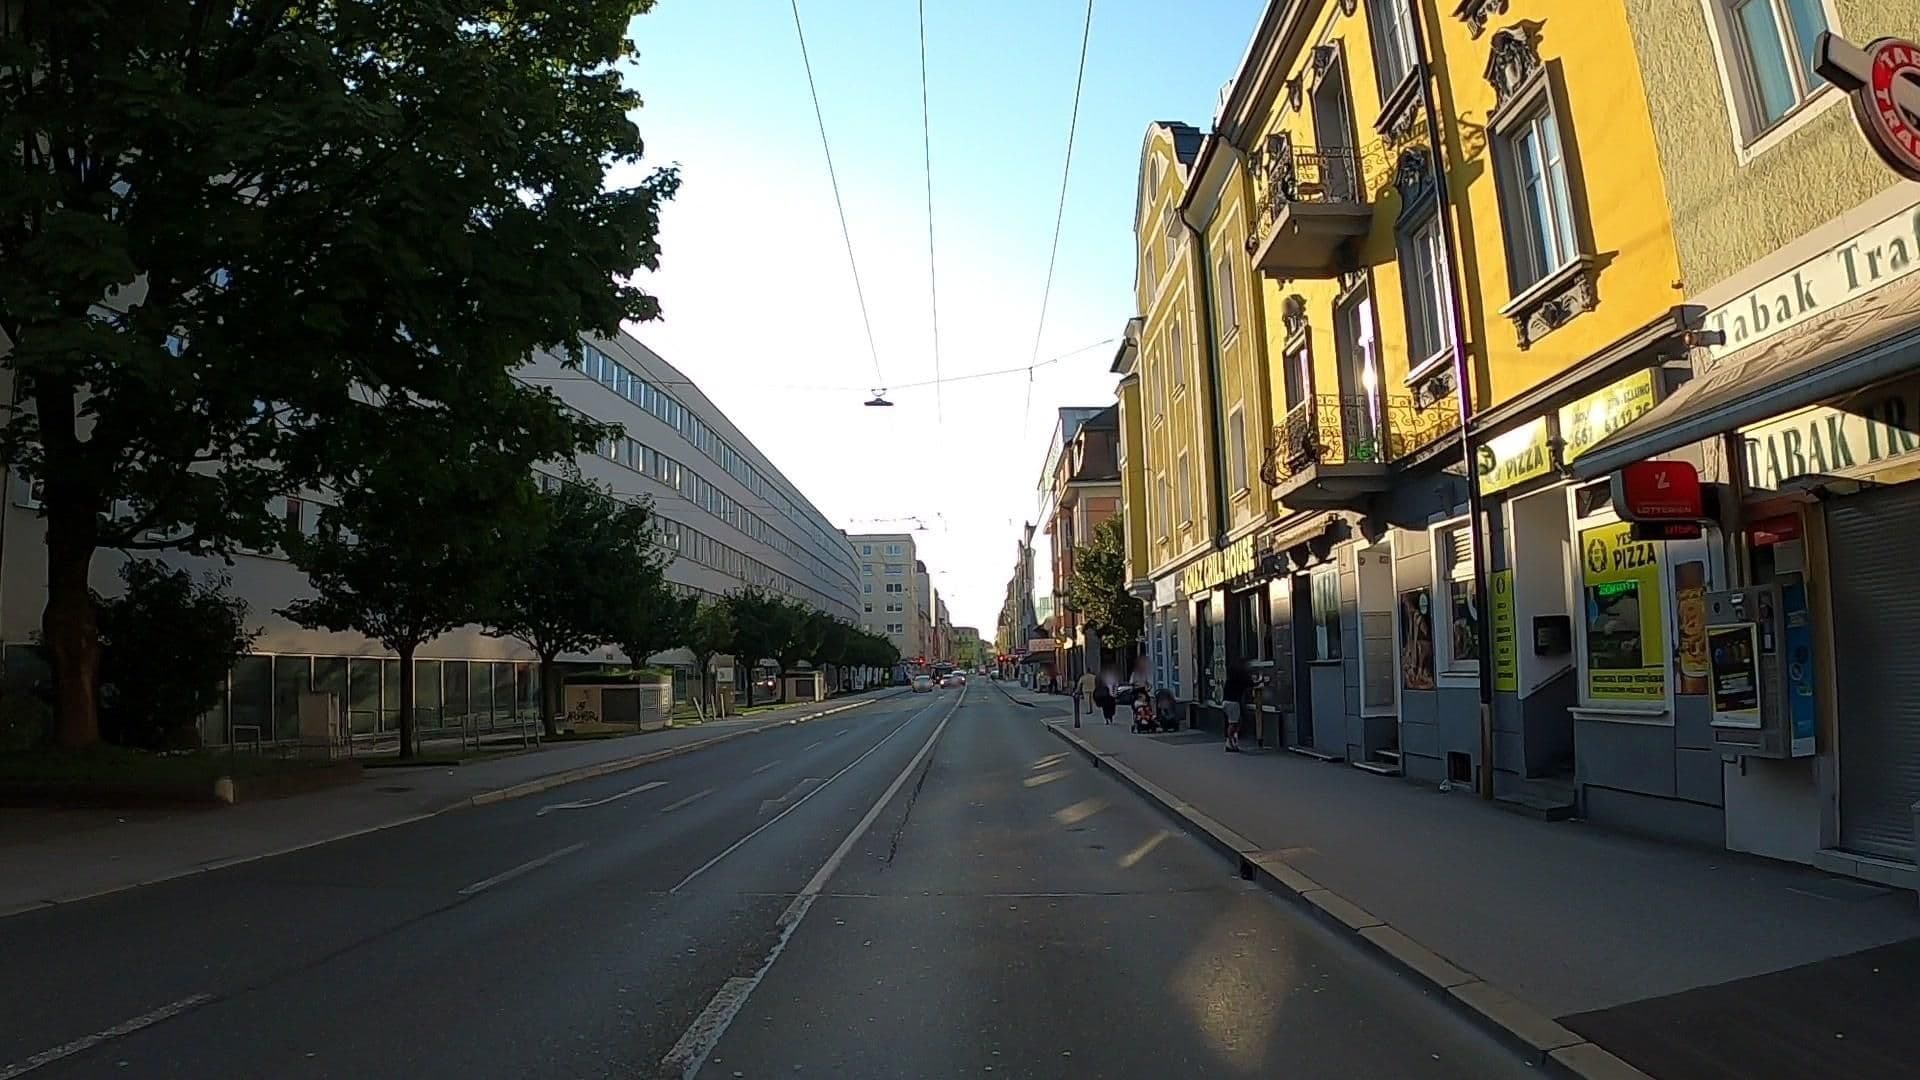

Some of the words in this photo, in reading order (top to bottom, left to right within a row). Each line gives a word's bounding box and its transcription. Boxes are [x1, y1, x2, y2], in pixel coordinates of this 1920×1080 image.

[1711, 270, 1819, 344] Tabak
[1505, 445, 1544, 480] PIZZA
[1744, 411, 1856, 490] TABAK
[1865, 394, 1920, 464] TR
[1224, 533, 1255, 581] HOUSE
[1612, 542, 1657, 571] PIZZA
